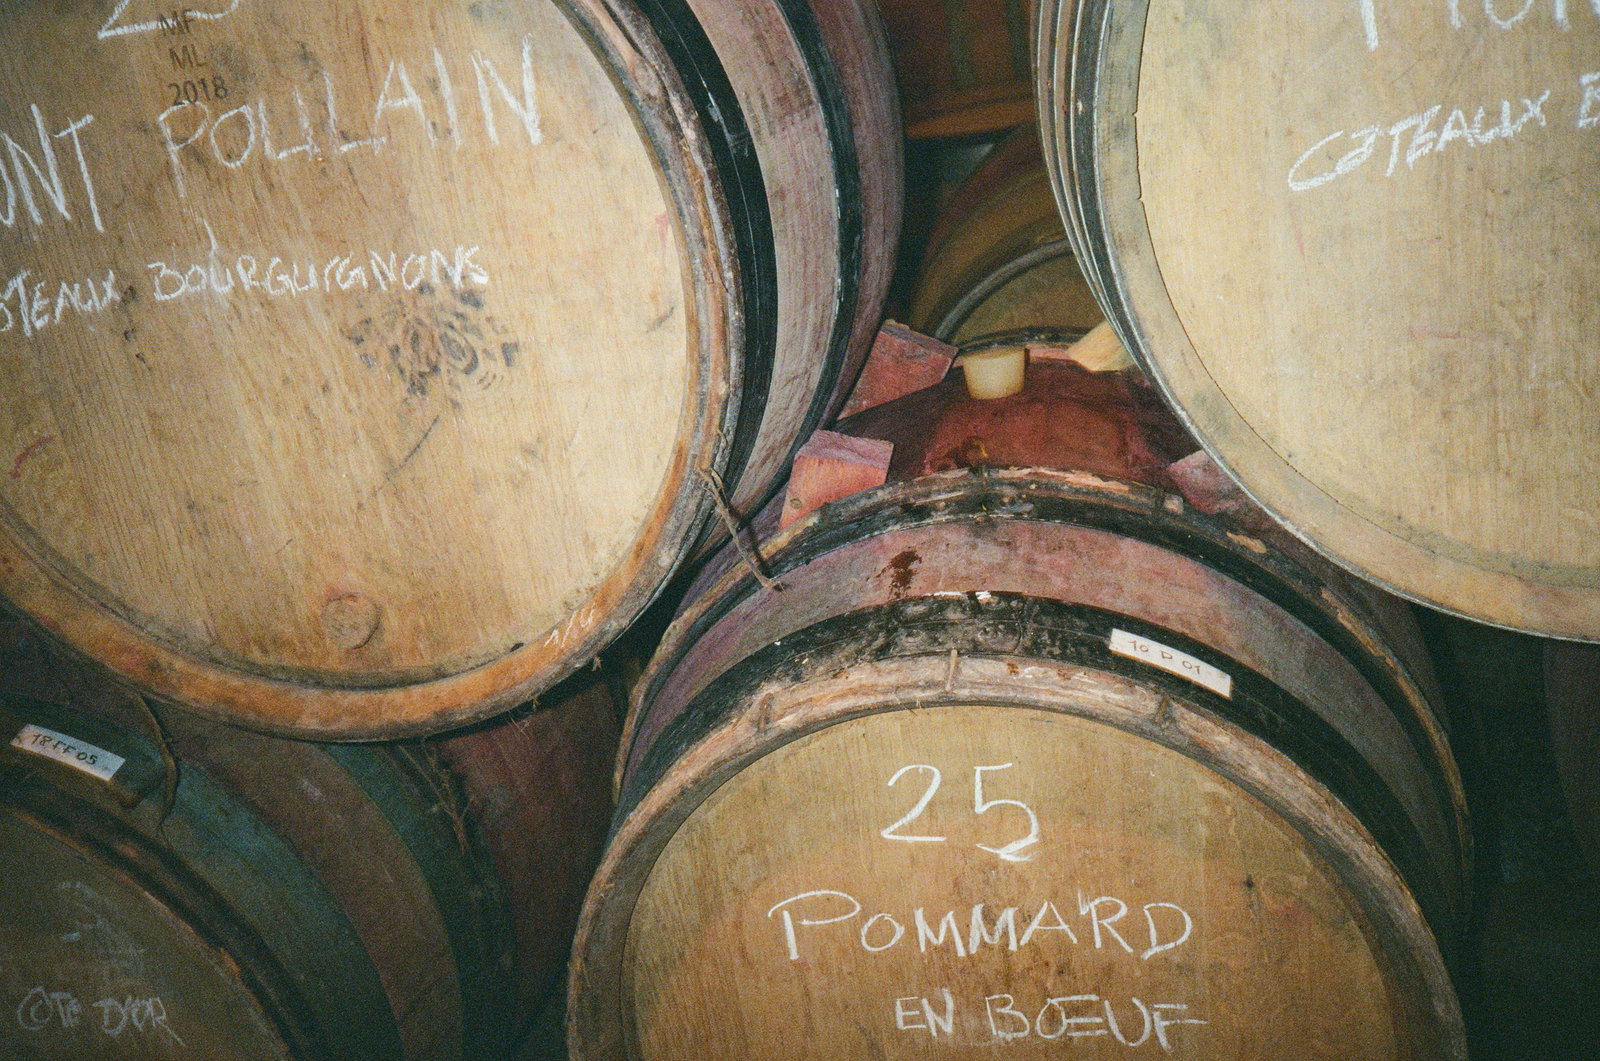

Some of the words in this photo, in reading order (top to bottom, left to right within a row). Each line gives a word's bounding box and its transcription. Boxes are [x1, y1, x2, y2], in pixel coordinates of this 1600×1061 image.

[158, 9, 197, 37] MF
[168, 44, 206, 72] ML
[167, 74, 229, 106] 2018
[880, 762, 1040, 862] 25
[767, 889, 1193, 961] POMMARD
[894, 988, 954, 1038] EN
